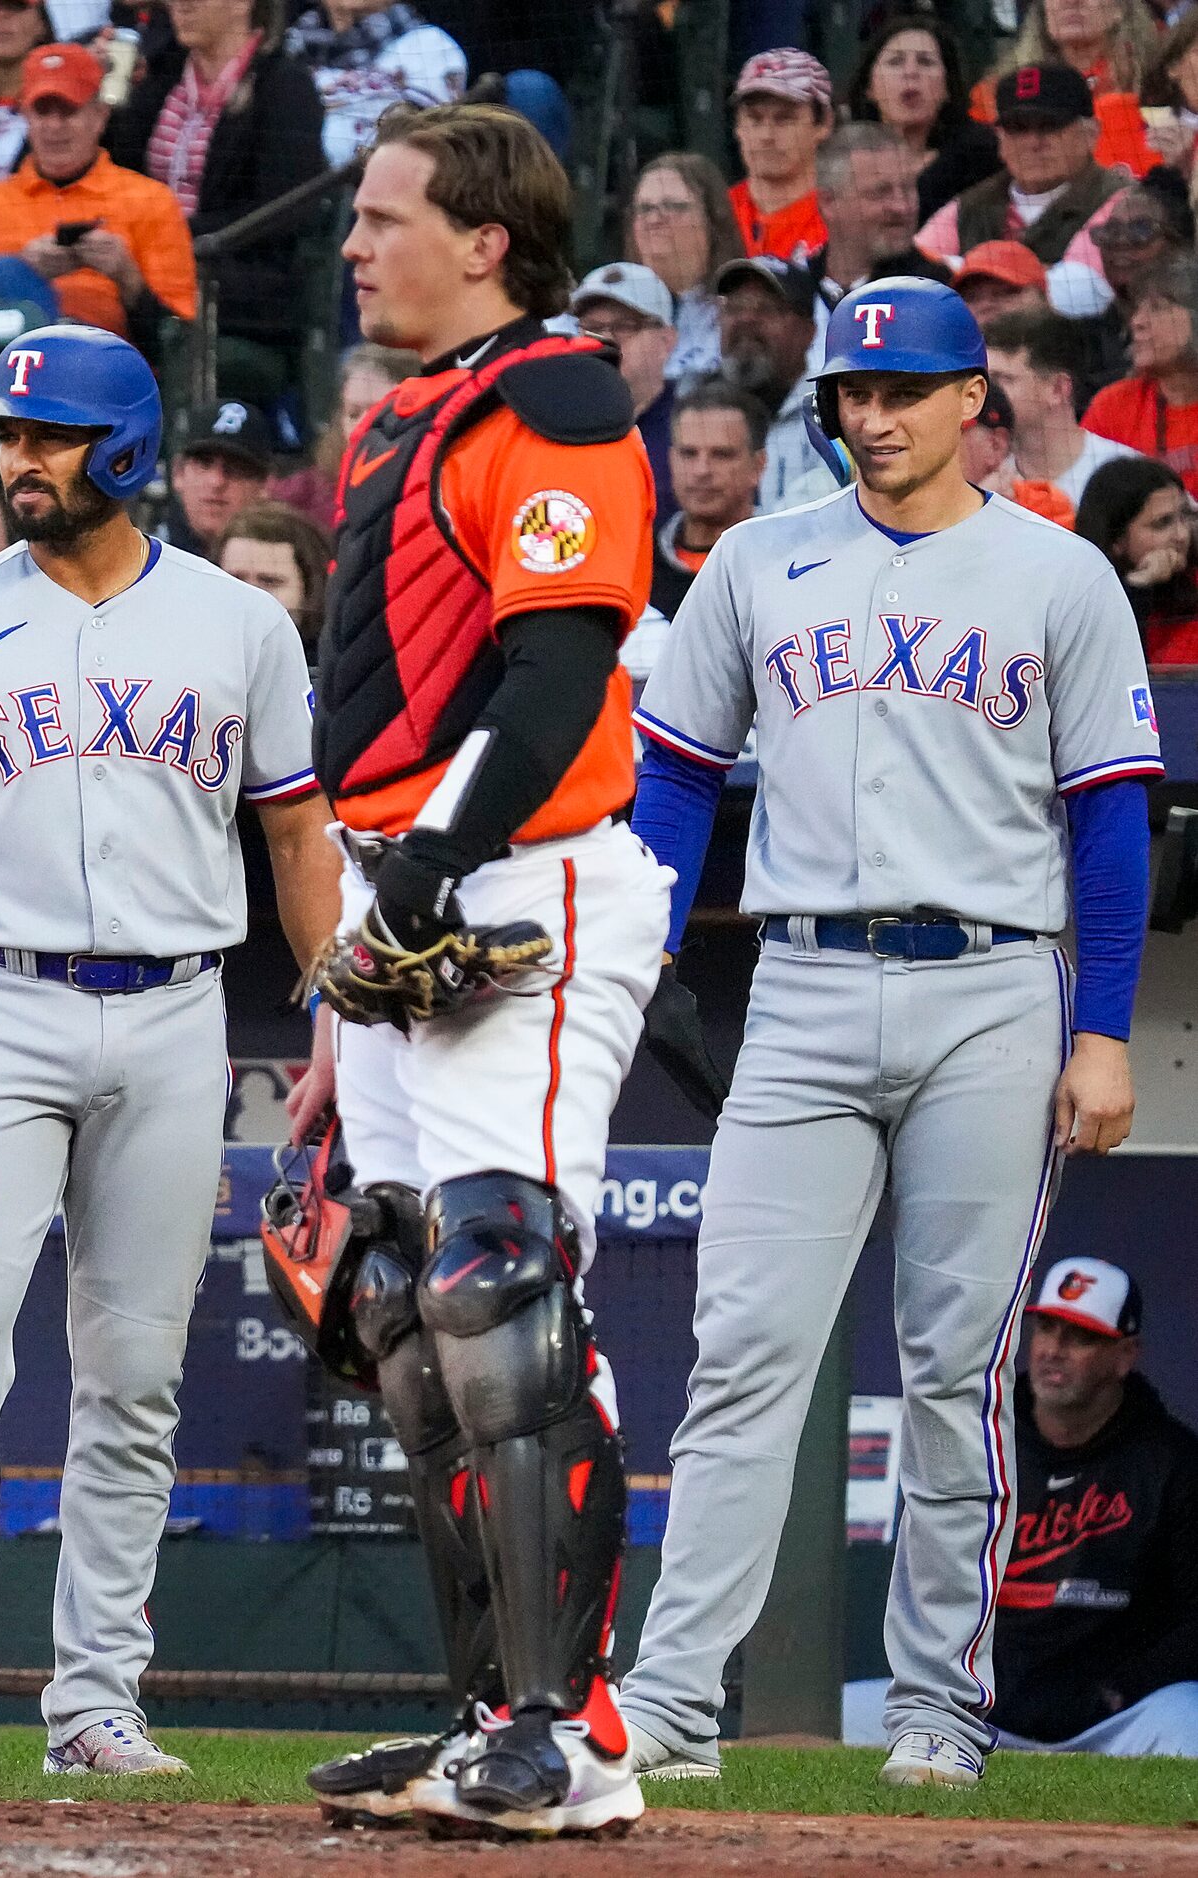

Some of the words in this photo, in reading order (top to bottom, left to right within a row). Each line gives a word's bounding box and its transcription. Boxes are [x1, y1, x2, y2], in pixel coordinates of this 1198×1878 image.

[854, 303, 895, 349] T
[7, 350, 44, 397] T
[764, 613, 1045, 730] TEXAS
[594, 1178, 708, 1229] ng.c
